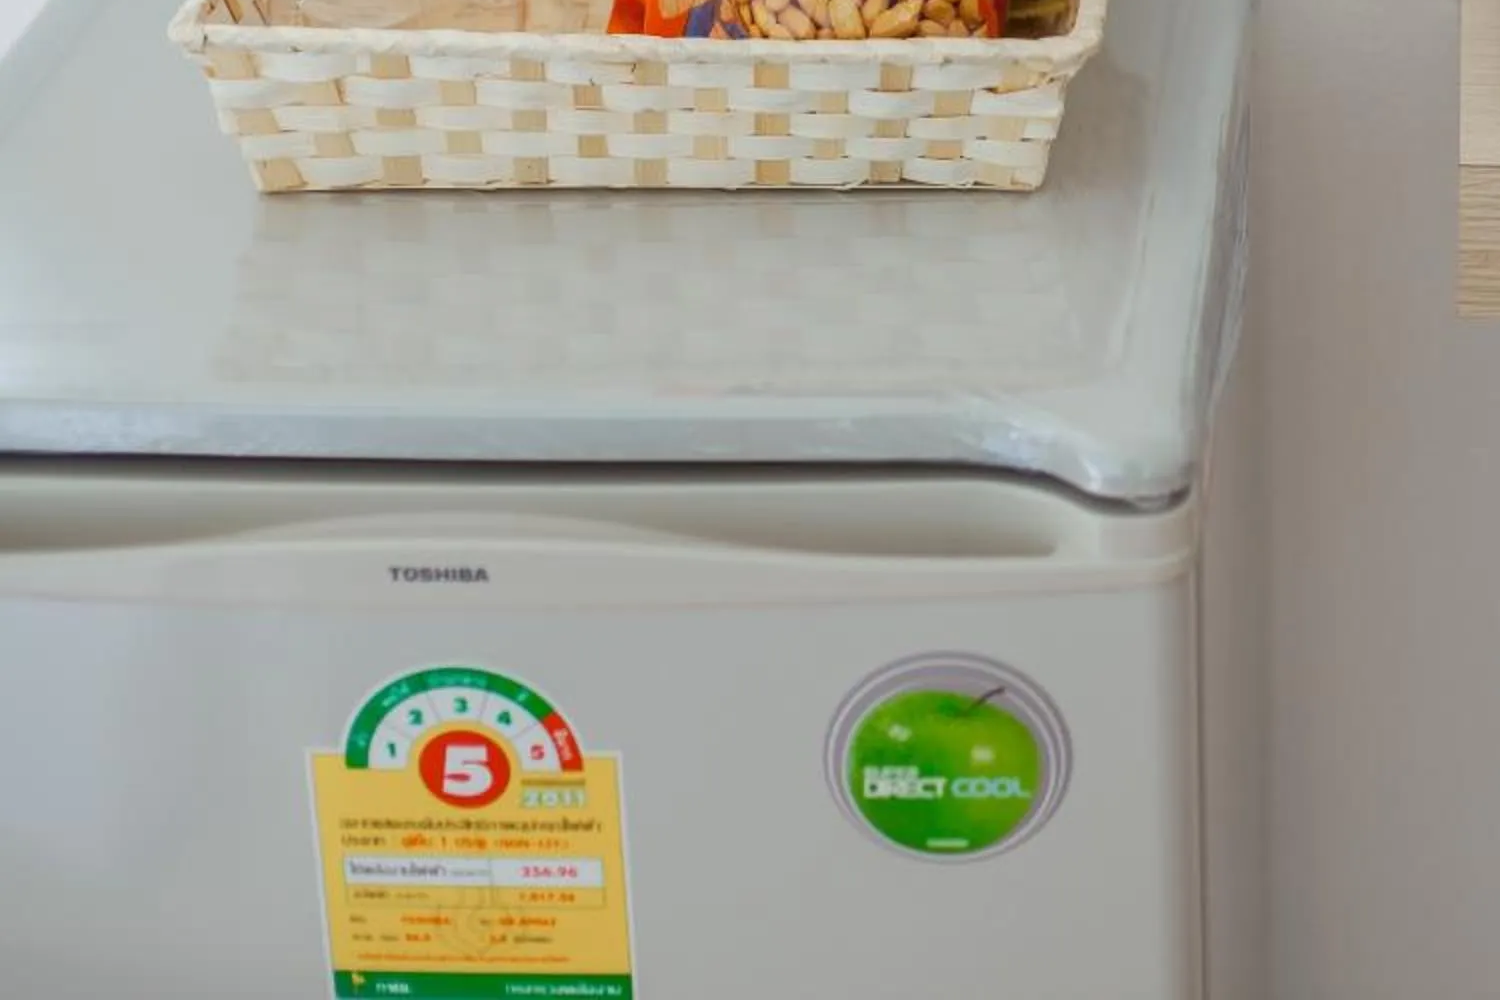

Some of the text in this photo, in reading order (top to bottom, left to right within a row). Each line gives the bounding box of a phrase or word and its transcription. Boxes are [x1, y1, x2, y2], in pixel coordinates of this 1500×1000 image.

[387, 566, 490, 583] TOSHIBA
[386, 697, 546, 761] 1 2 3 4 5
[443, 744, 495, 798] 5
[951, 776, 1031, 799] COOL
